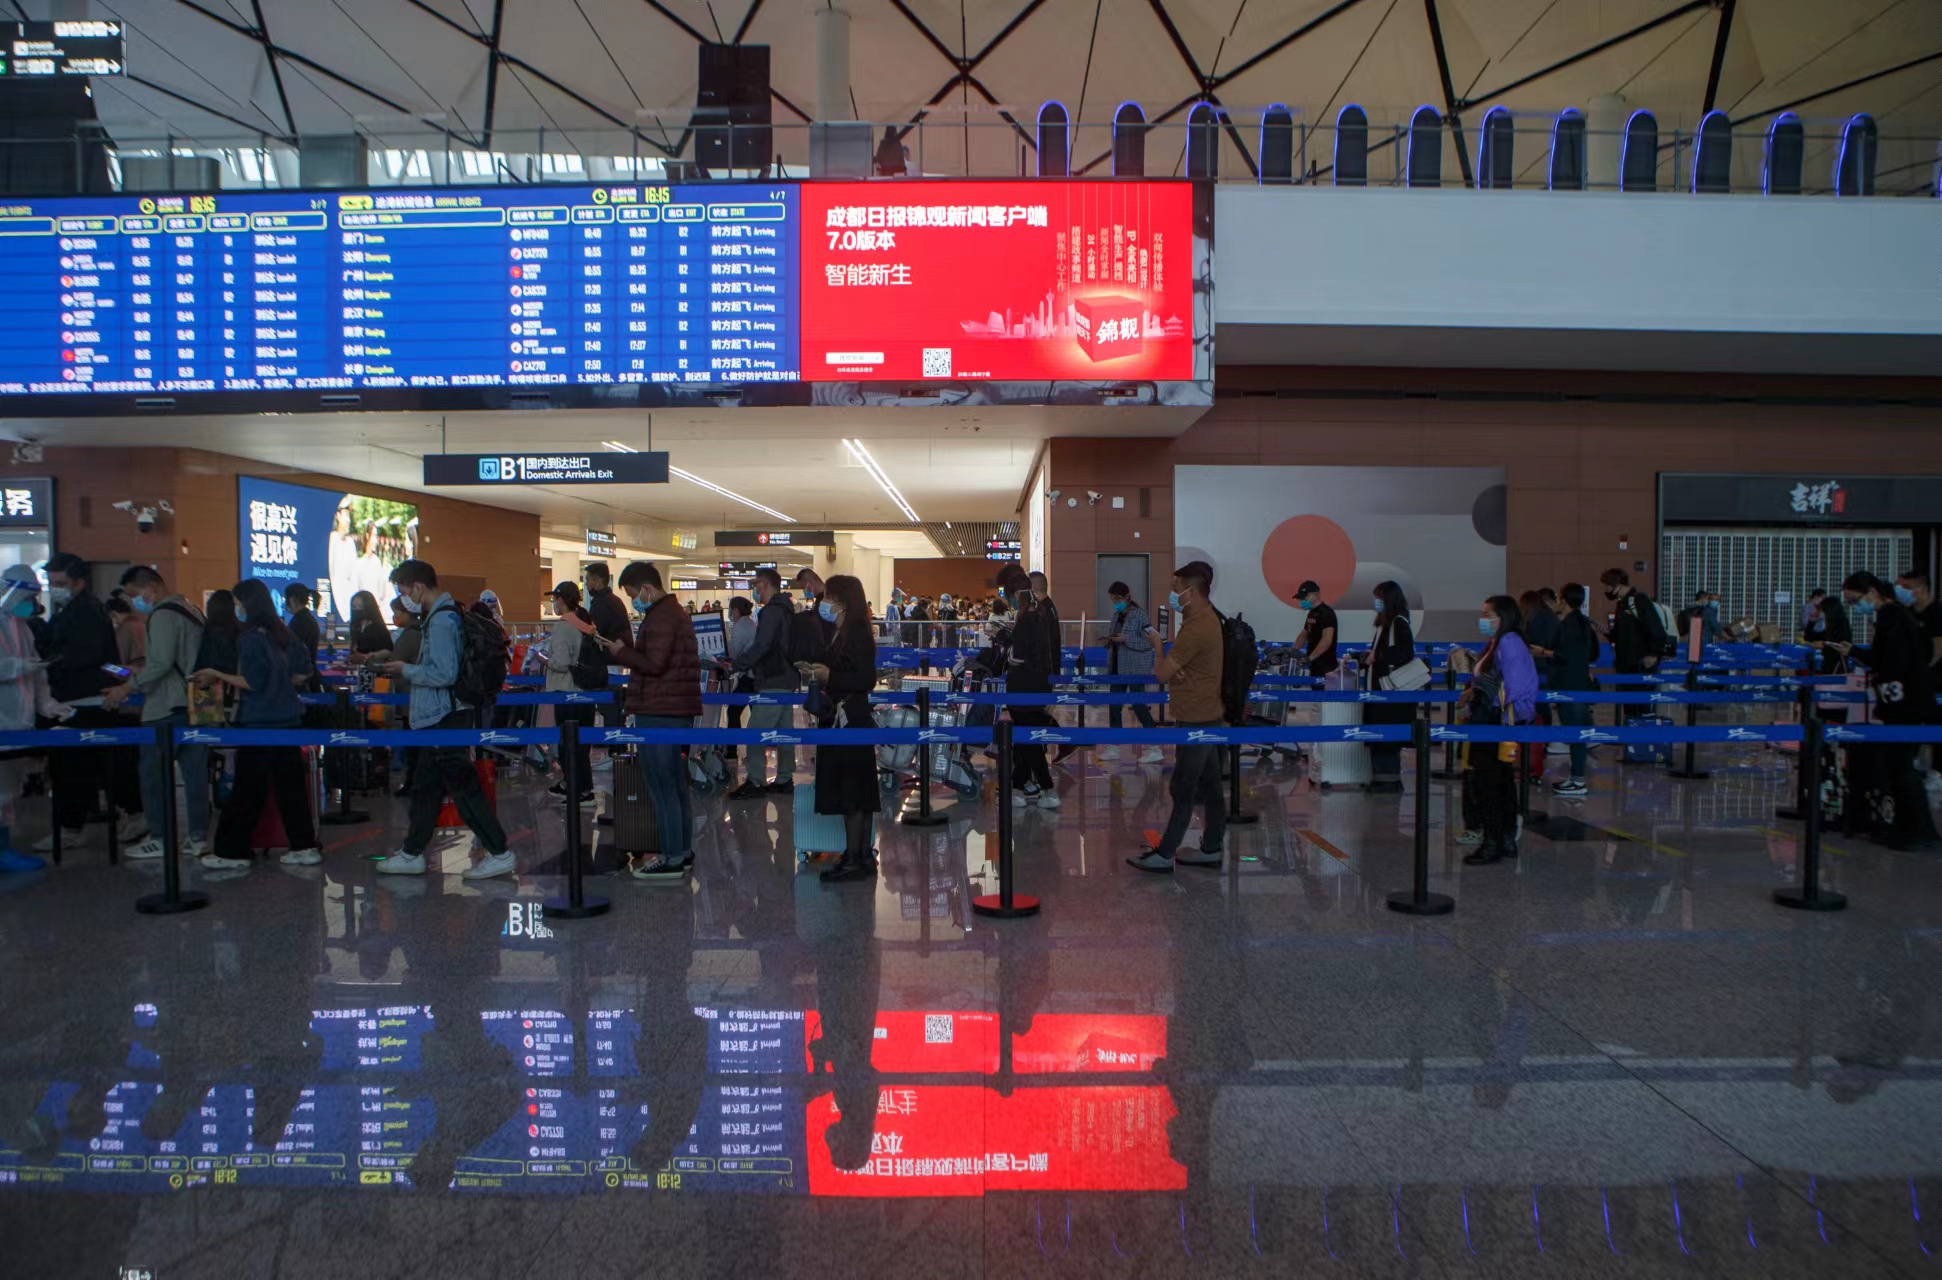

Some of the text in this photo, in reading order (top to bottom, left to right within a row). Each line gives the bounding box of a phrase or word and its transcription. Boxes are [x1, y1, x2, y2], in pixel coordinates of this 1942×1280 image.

[645, 186, 670, 203] 16:15
[770, 191, 785, 200] 4/7
[668, 208, 684, 217] 出口
[826, 206, 1048, 227] 成都日报锦观新闻客户端
[585, 228, 601, 238] 16:40
[679, 227, 688, 236] B2
[712, 226, 775, 236] 前方起飞 Arriving
[826, 230, 896, 250] 7.0版本
[585, 247, 601, 256] 16:55
[680, 246, 686, 255] B1
[712, 244, 775, 255] 前方起飞 Arriving
[585, 266, 601, 275] 16:55
[679, 264, 687, 274] B2
[712, 264, 775, 274] 前方起飞 Arriving
[826, 264, 912, 286] 智能新生
[585, 285, 600, 294] 17:20
[680, 283, 686, 293] B1
[712, 282, 775, 293] 前方起飞 Arriving
[585, 303, 600, 313] 17:35
[679, 302, 687, 311] B2
[712, 301, 775, 312] 前方起飞 Arriving
[585, 322, 600, 331] 17:40
[679, 321, 687, 330] B2
[712, 320, 751, 330] 前方起飞
[585, 341, 600, 350] 17:40
[680, 340, 686, 349] B1
[712, 339, 751, 349] 前方起飞
[585, 360, 600, 369] 17:50
[679, 359, 687, 368] B2
[712, 358, 775, 368] 前方起飞 Arriving
[500, 457, 526, 480] B1
[526, 458, 590, 469] 国内到达出口
[526, 470, 613, 479] Domestic Arrivals Exit
[250, 500, 297, 533] 很高兴
[251, 533, 298, 565] 遇见你
[252, 566, 266, 577] Nice
[273, 569, 287, 578] meet
[287, 570, 299, 580] you
[726, 581, 731, 589] 3
